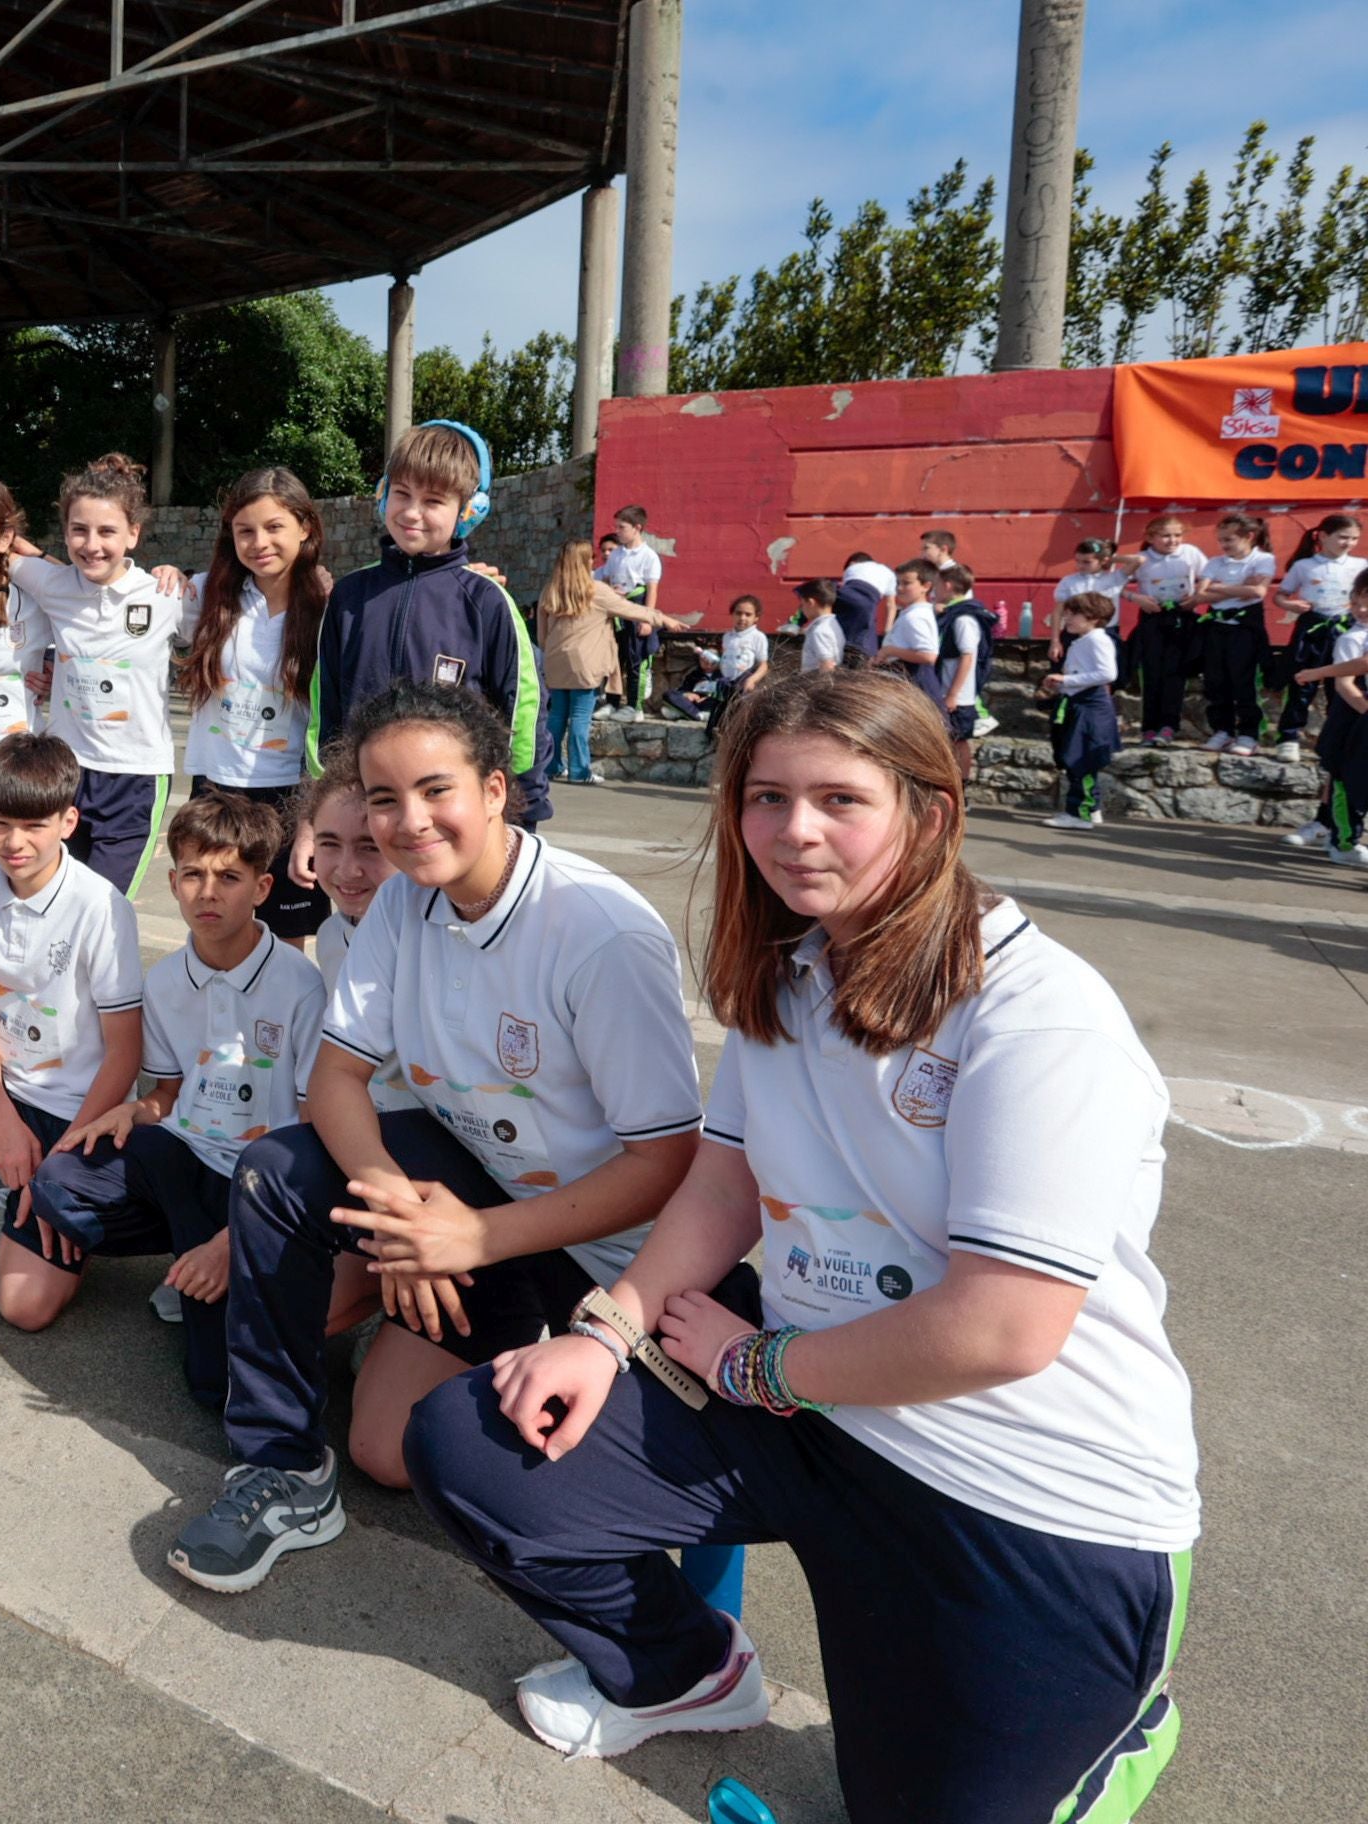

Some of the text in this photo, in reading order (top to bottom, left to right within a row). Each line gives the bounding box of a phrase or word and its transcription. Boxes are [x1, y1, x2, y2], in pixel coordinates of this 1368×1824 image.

[1292, 365, 1368, 415] U
[1234, 443, 1366, 481] CON
[824, 1255, 872, 1278] VUELTA
[817, 1274, 828, 1288] al
[831, 1275, 864, 1295] COLE
